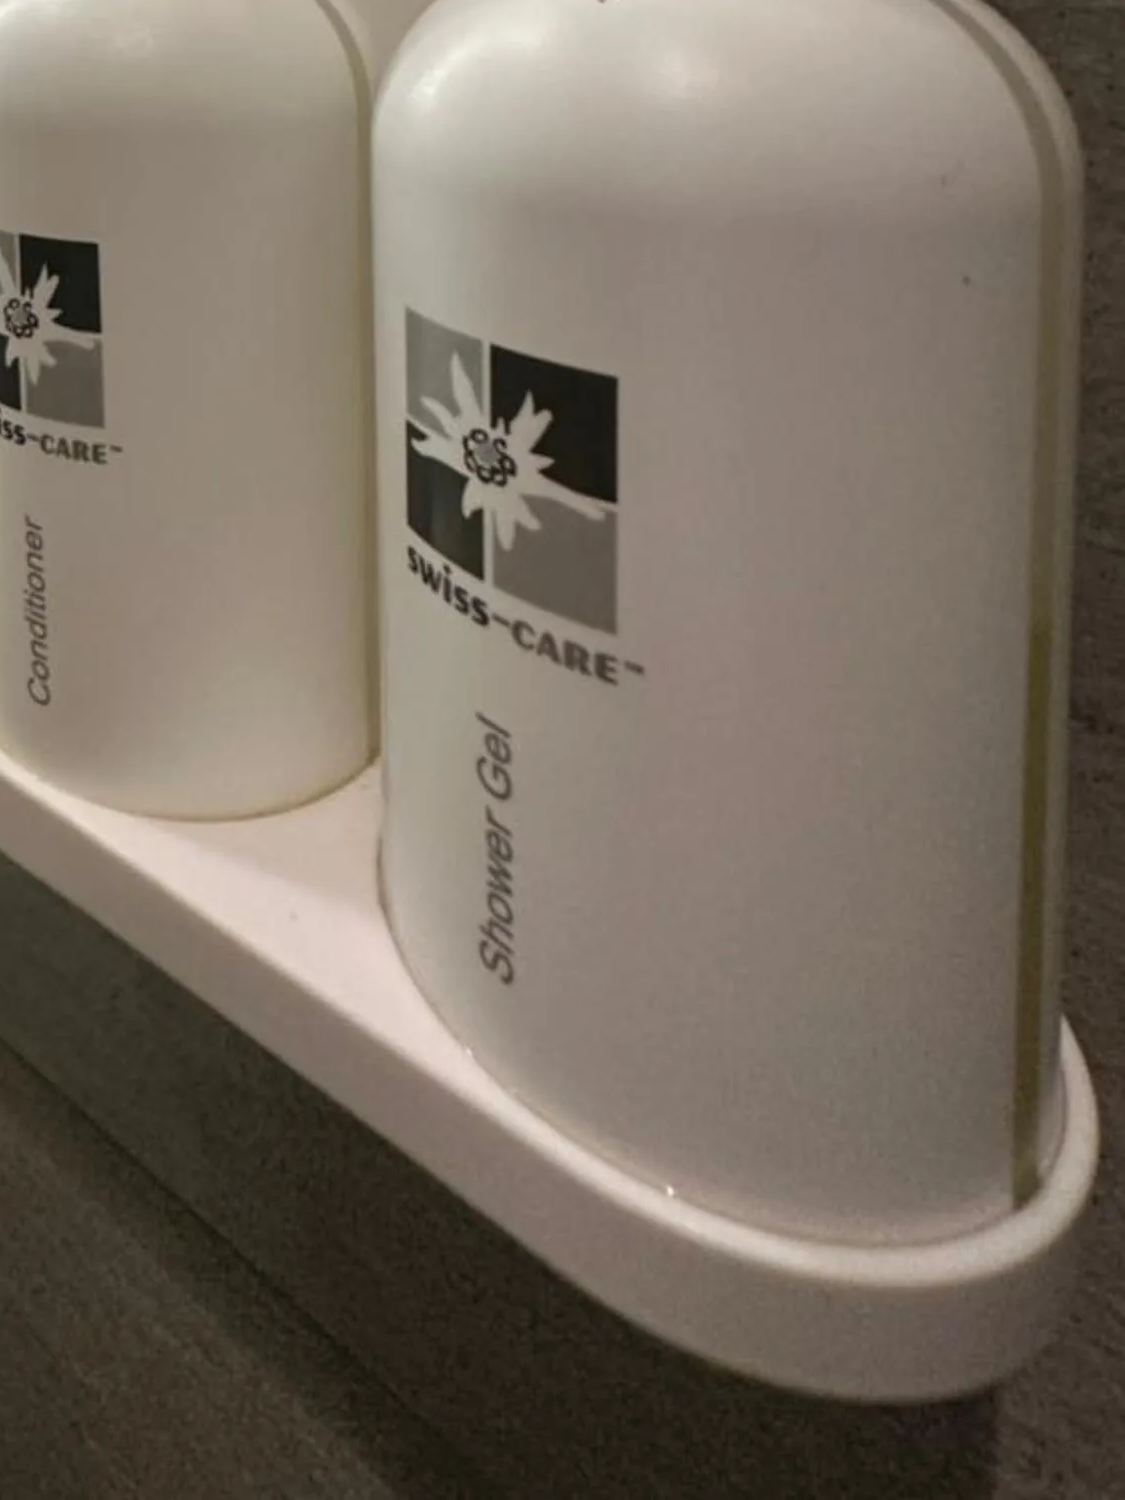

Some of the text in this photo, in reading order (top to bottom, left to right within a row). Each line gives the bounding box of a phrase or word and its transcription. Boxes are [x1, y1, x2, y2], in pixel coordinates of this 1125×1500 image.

[24, 514, 51, 706] Conditioner
[476, 712, 515, 986] Shower Gel
